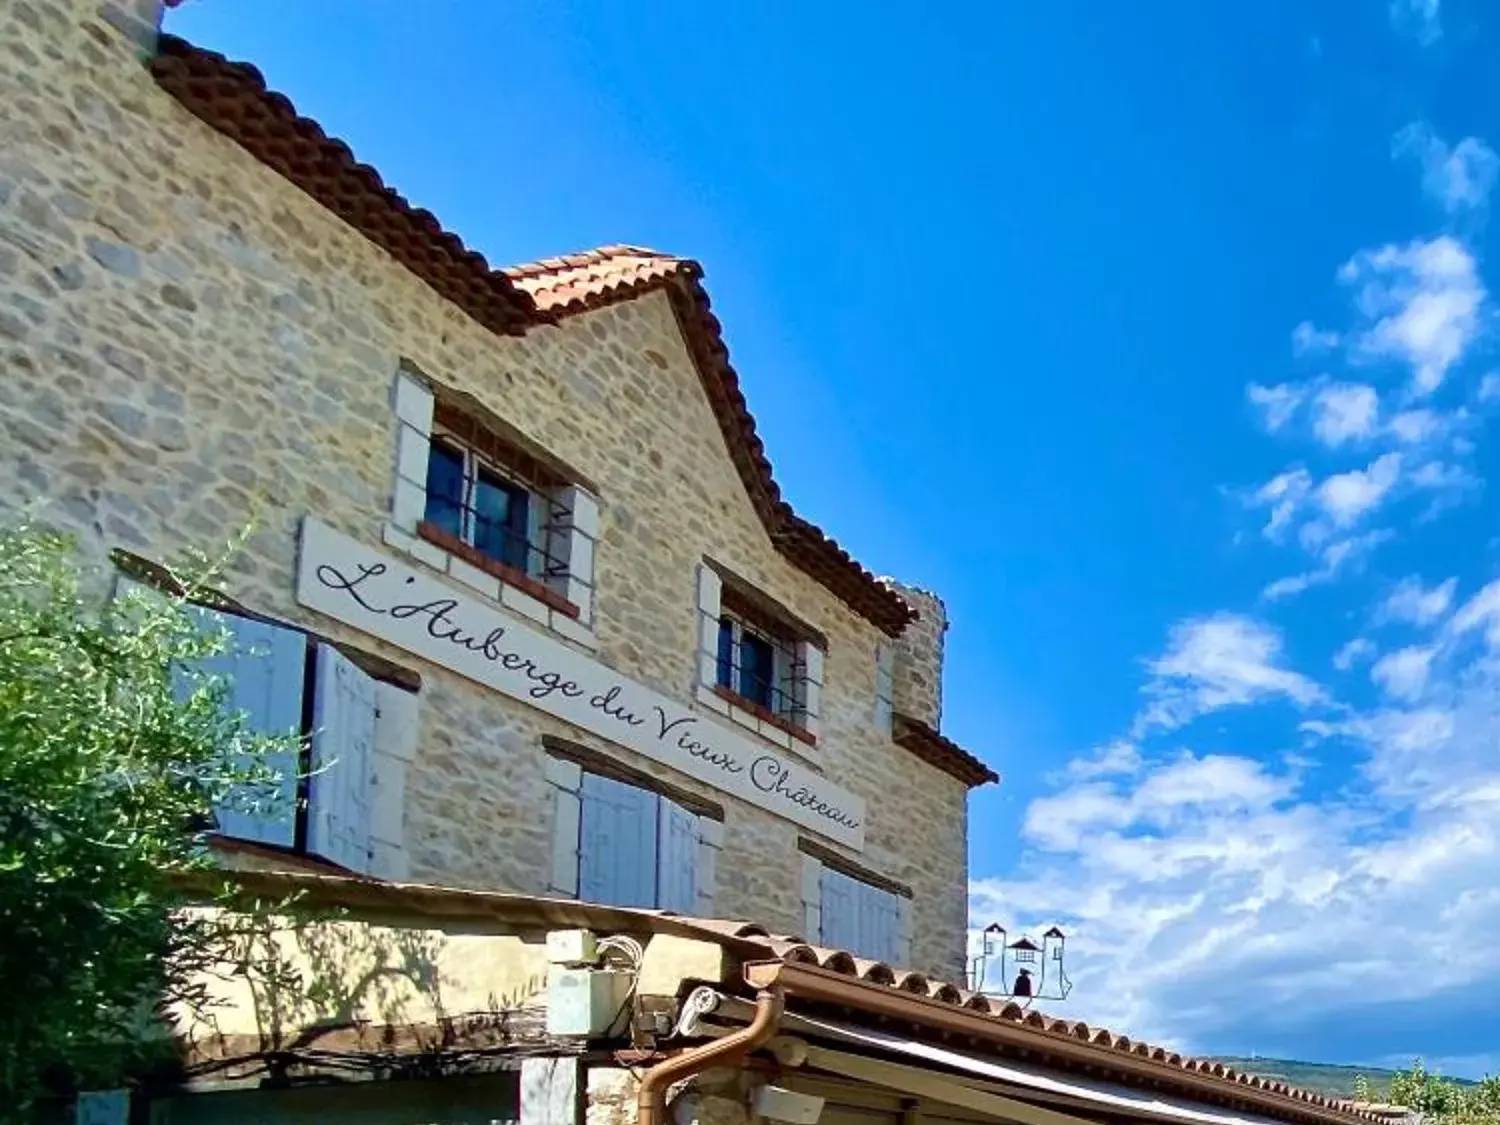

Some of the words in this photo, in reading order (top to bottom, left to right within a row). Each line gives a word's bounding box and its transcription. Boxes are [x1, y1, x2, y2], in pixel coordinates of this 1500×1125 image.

[317, 562, 584, 698] L'Auberge
[590, 685, 644, 726] du
[653, 705, 744, 774] Vieux
[751, 754, 859, 830] Château
